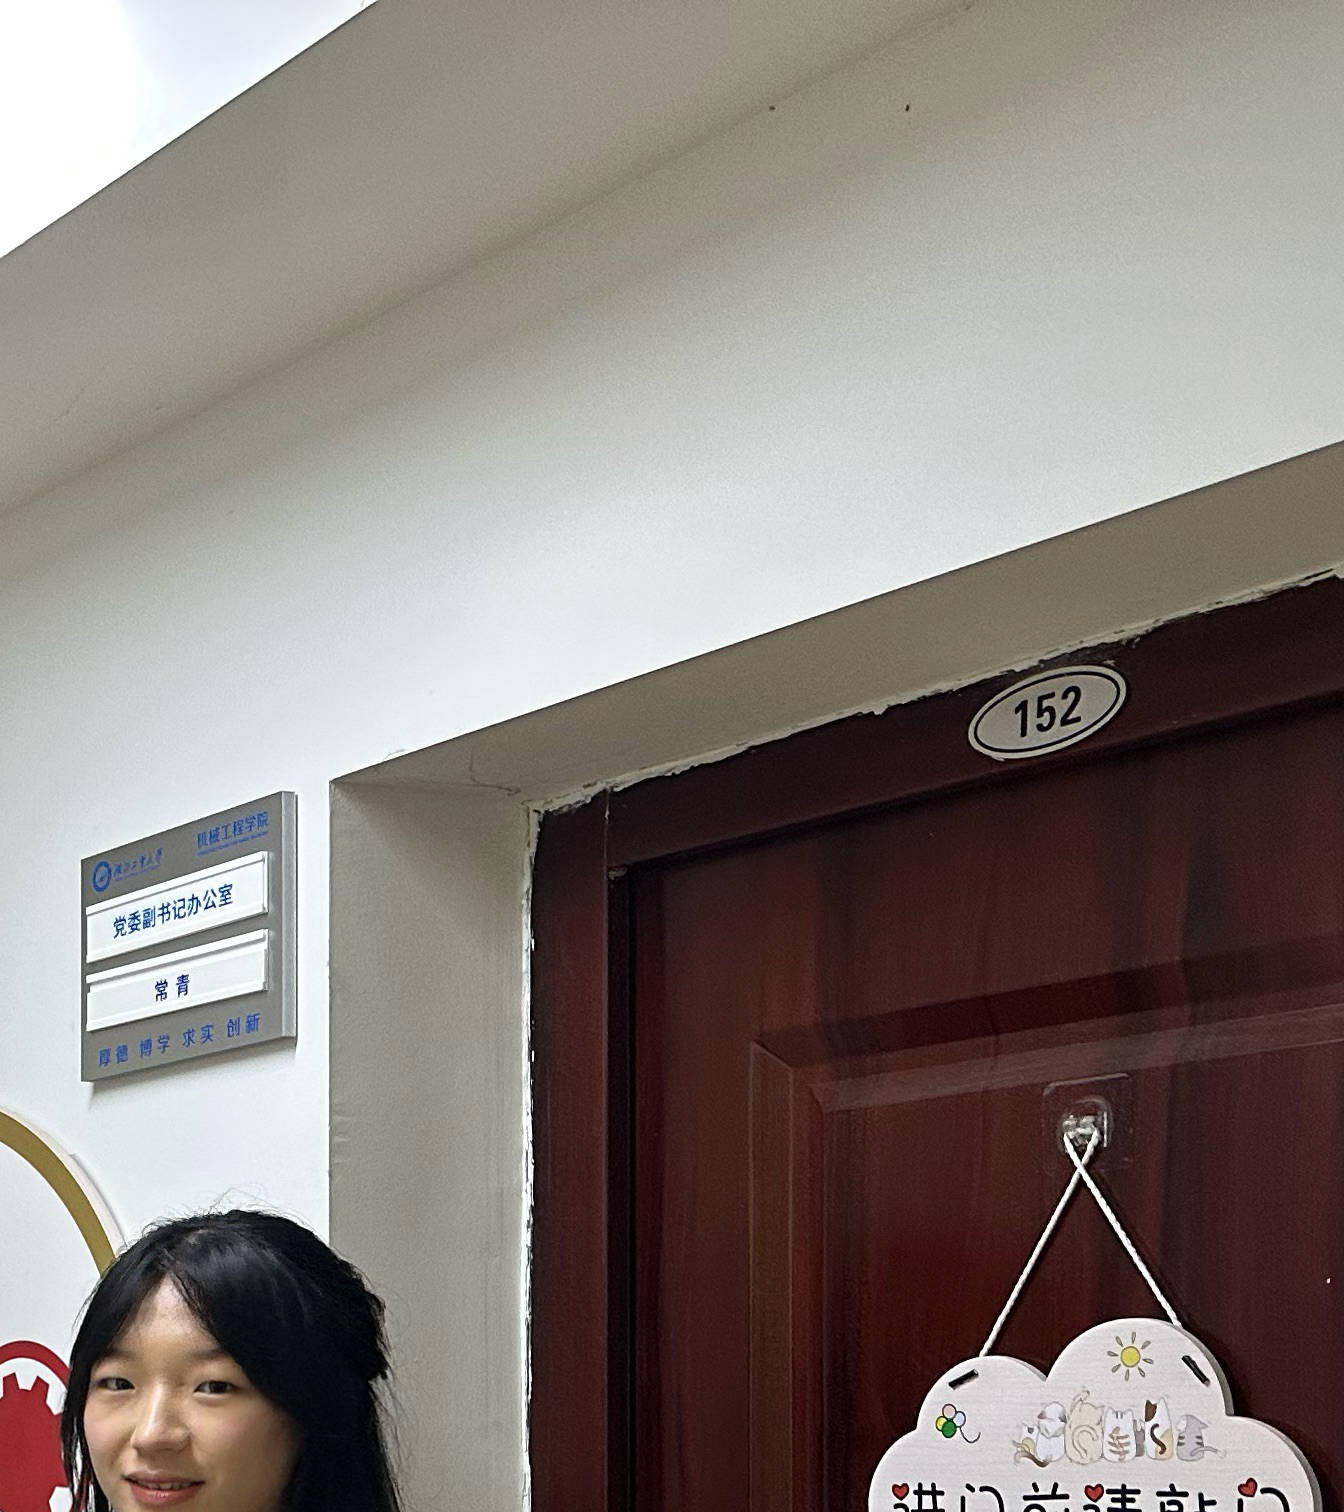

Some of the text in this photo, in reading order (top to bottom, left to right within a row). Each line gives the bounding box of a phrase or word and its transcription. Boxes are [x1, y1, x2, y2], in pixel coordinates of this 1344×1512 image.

[1015, 685, 1082, 738] 152
[196, 811, 270, 849] 机械工程学院
[113, 883, 234, 939] 党委副书记办公室
[155, 973, 191, 1002] 常青
[98, 1012, 261, 1068] 厚德 博学 求实 创新
